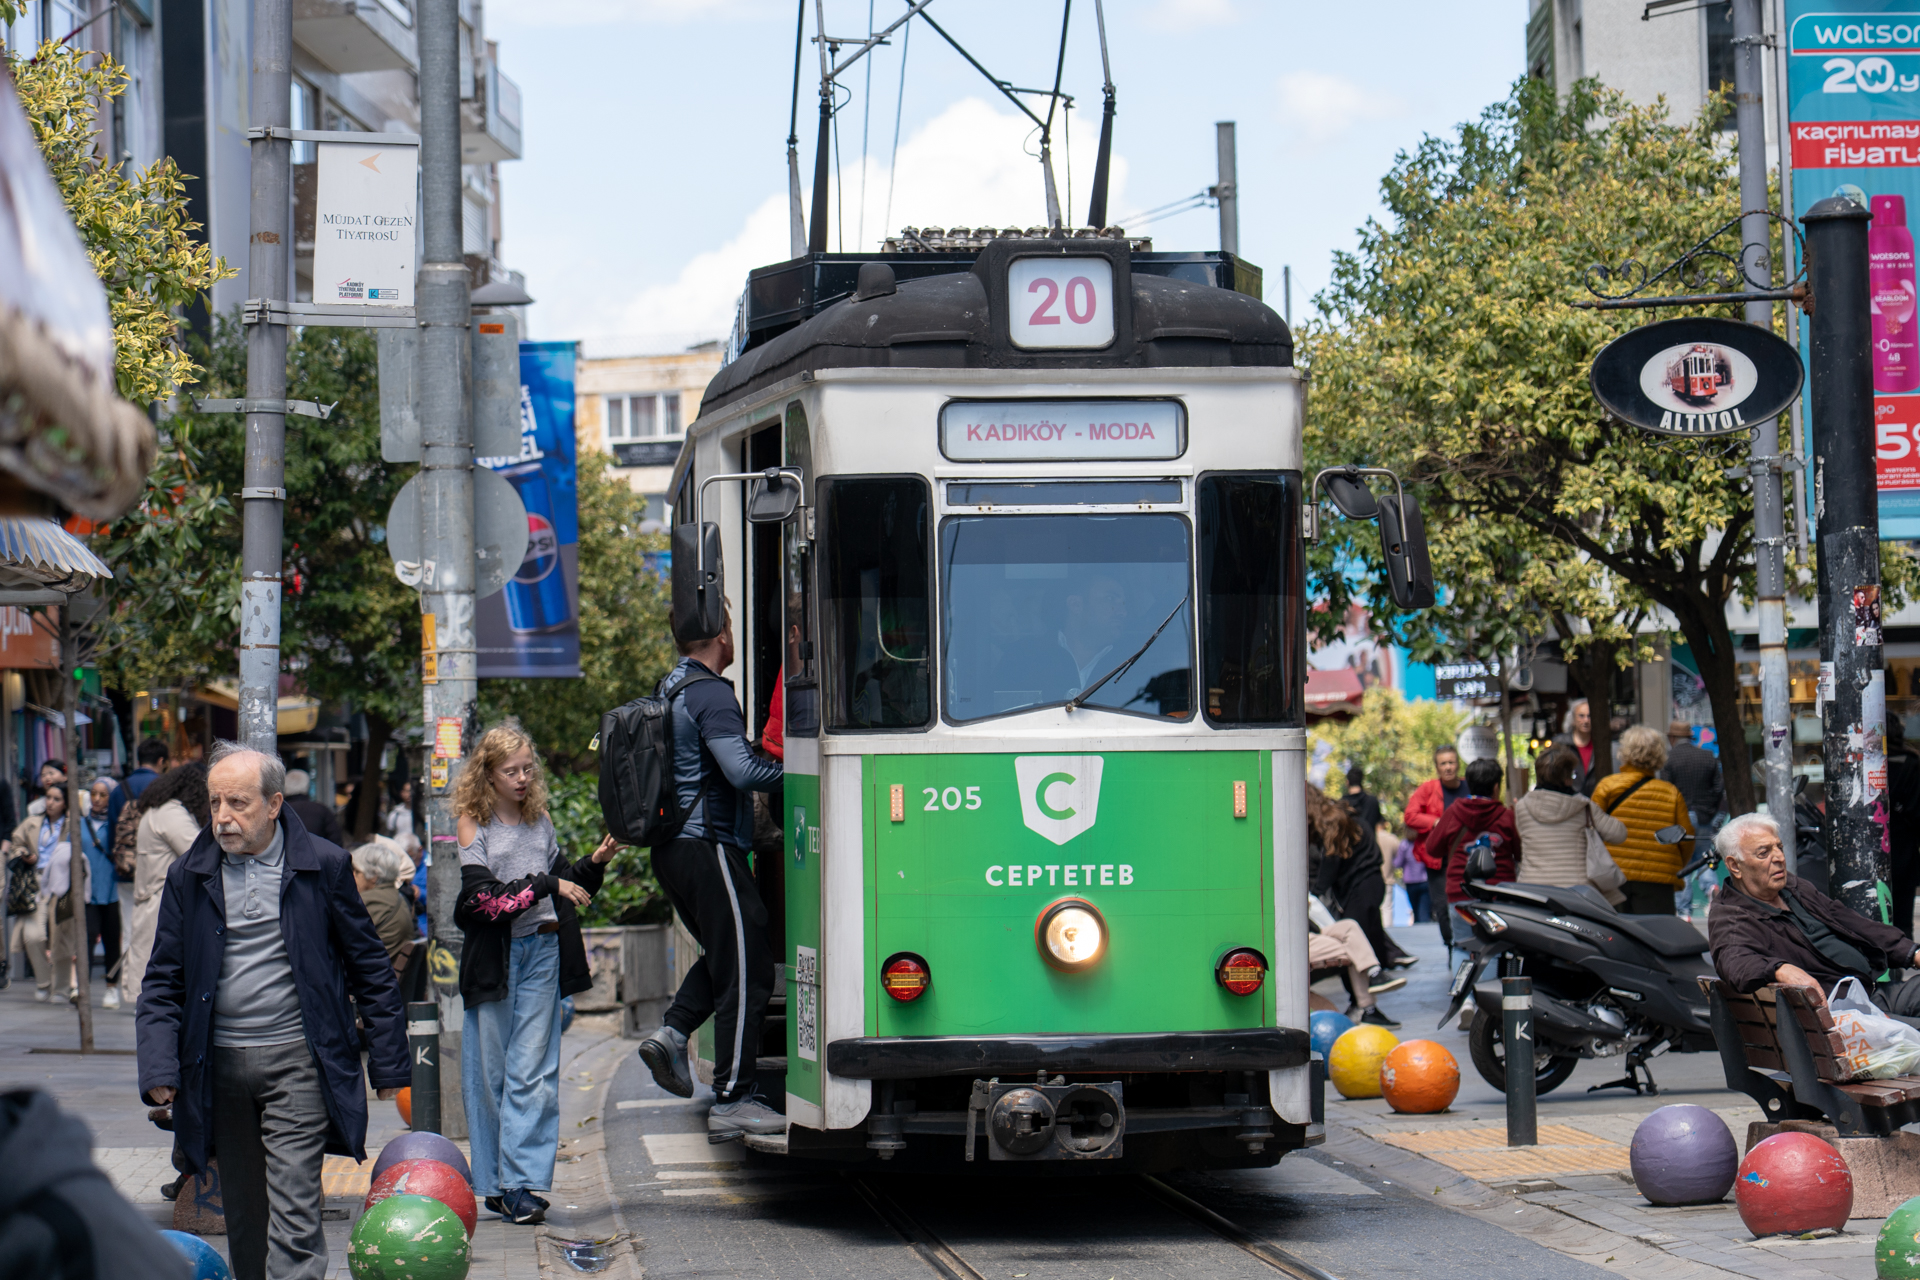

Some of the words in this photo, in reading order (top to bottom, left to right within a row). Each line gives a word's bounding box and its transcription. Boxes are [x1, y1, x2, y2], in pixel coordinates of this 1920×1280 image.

[323, 214, 371, 225] MÜJDAT
[373, 215, 413, 226] GEZEN
[336, 229, 399, 241] TİYATROSU
[1870, 252, 1910, 260] watsons
[1027, 276, 1097, 325] 20
[967, 420, 1067, 441] KADIKÖY
[1089, 423, 1155, 440] MODA
[1659, 408, 1746, 432] ALTIYOL
[922, 786, 982, 811] 205
[985, 864, 1134, 886] CEPTETEB
